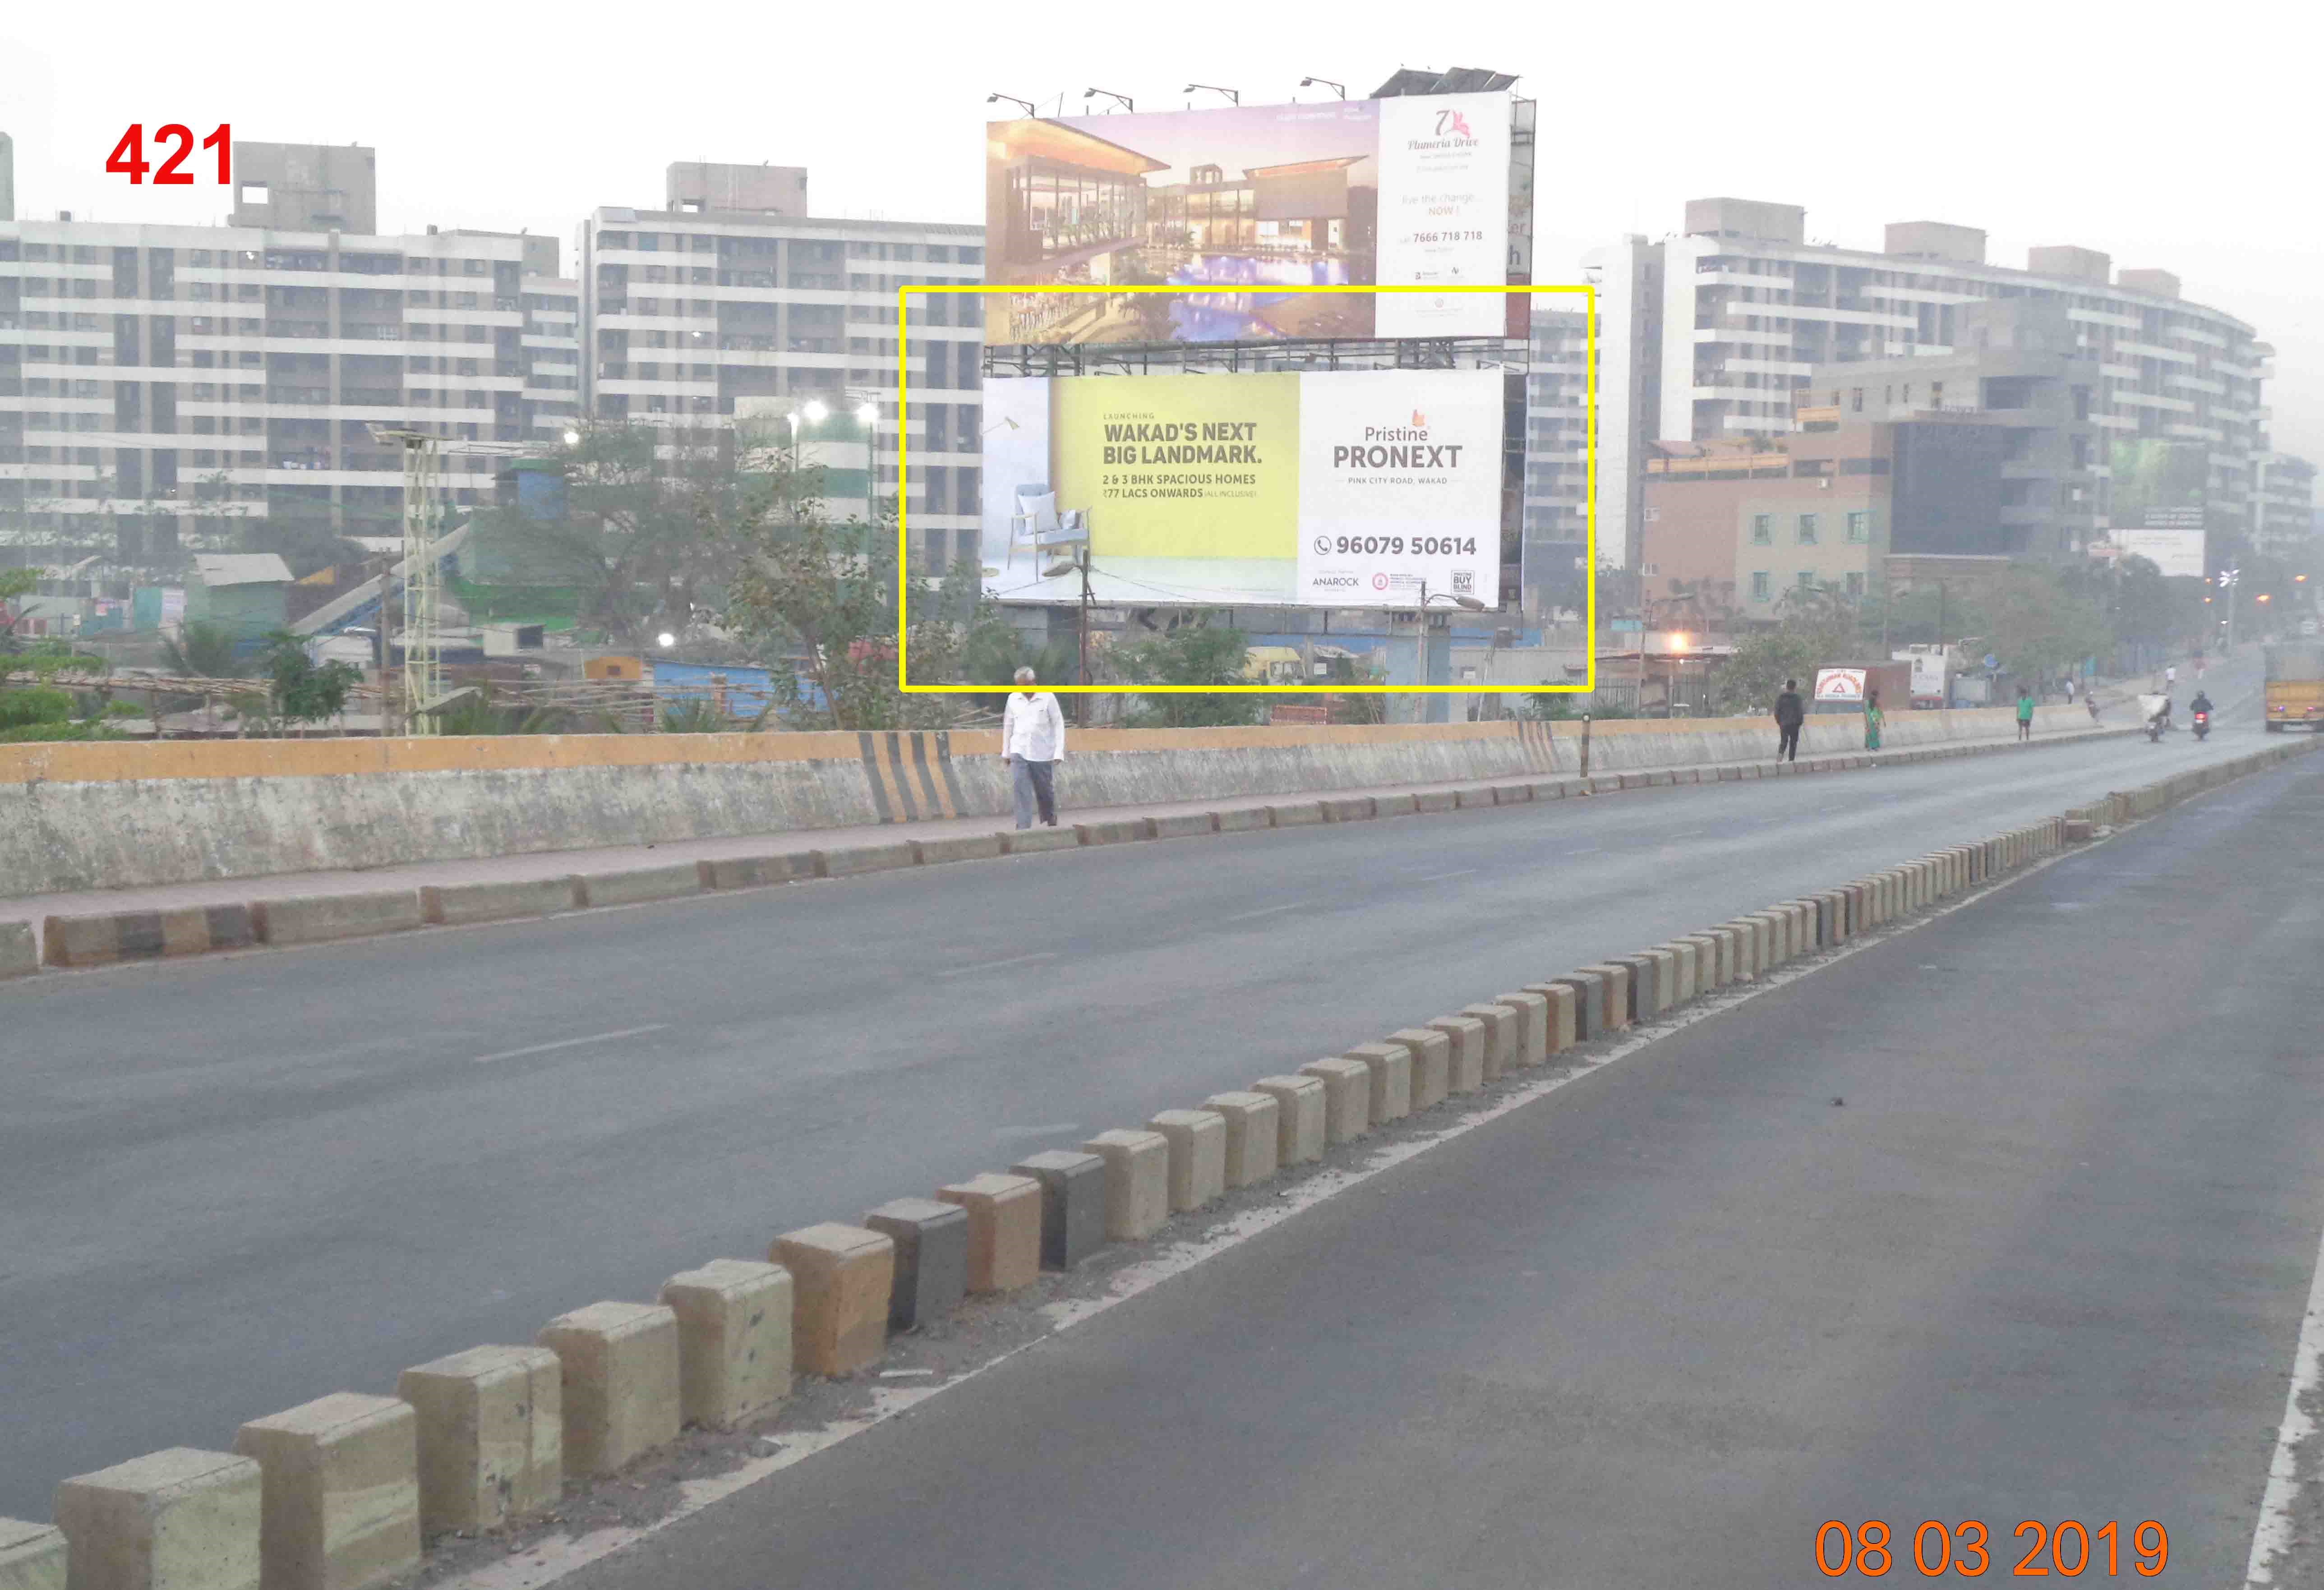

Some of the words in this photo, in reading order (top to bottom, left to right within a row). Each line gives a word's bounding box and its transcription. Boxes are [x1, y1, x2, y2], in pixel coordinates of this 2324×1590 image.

[1407, 139, 1451, 150] Plumeria
[1453, 137, 1478, 147] Drive
[1429, 206, 1453, 216] NOW
[1414, 233, 1438, 243] 7666
[1442, 231, 1460, 241] 718
[1464, 230, 1483, 241] 718
[1104, 422, 1198, 442] WAKAD'S
[1202, 422, 1257, 441] NEXT
[1365, 426, 1428, 441] Pristine
[1103, 446, 1137, 465] BIG
[1142, 444, 1262, 464] LANDMARK.
[1334, 445, 1463, 468] PRONEXT
[1103, 475, 1109, 484] 2
[1112, 475, 1119, 485] &
[1122, 475, 1128, 484] 3
[1131, 475, 1153, 484] BHK
[1157, 474, 1212, 484] SPACIOUS
[1215, 474, 1256, 484] HOMES
[1391, 477, 1416, 486] ROAD,
[1122, 489, 1148, 498] LACS
[1150, 488, 1204, 498] ONWARDS
[1336, 536, 1404, 554] 96079
[1411, 537, 1476, 555] 50614
[1313, 577, 1359, 586] ANAROCK
